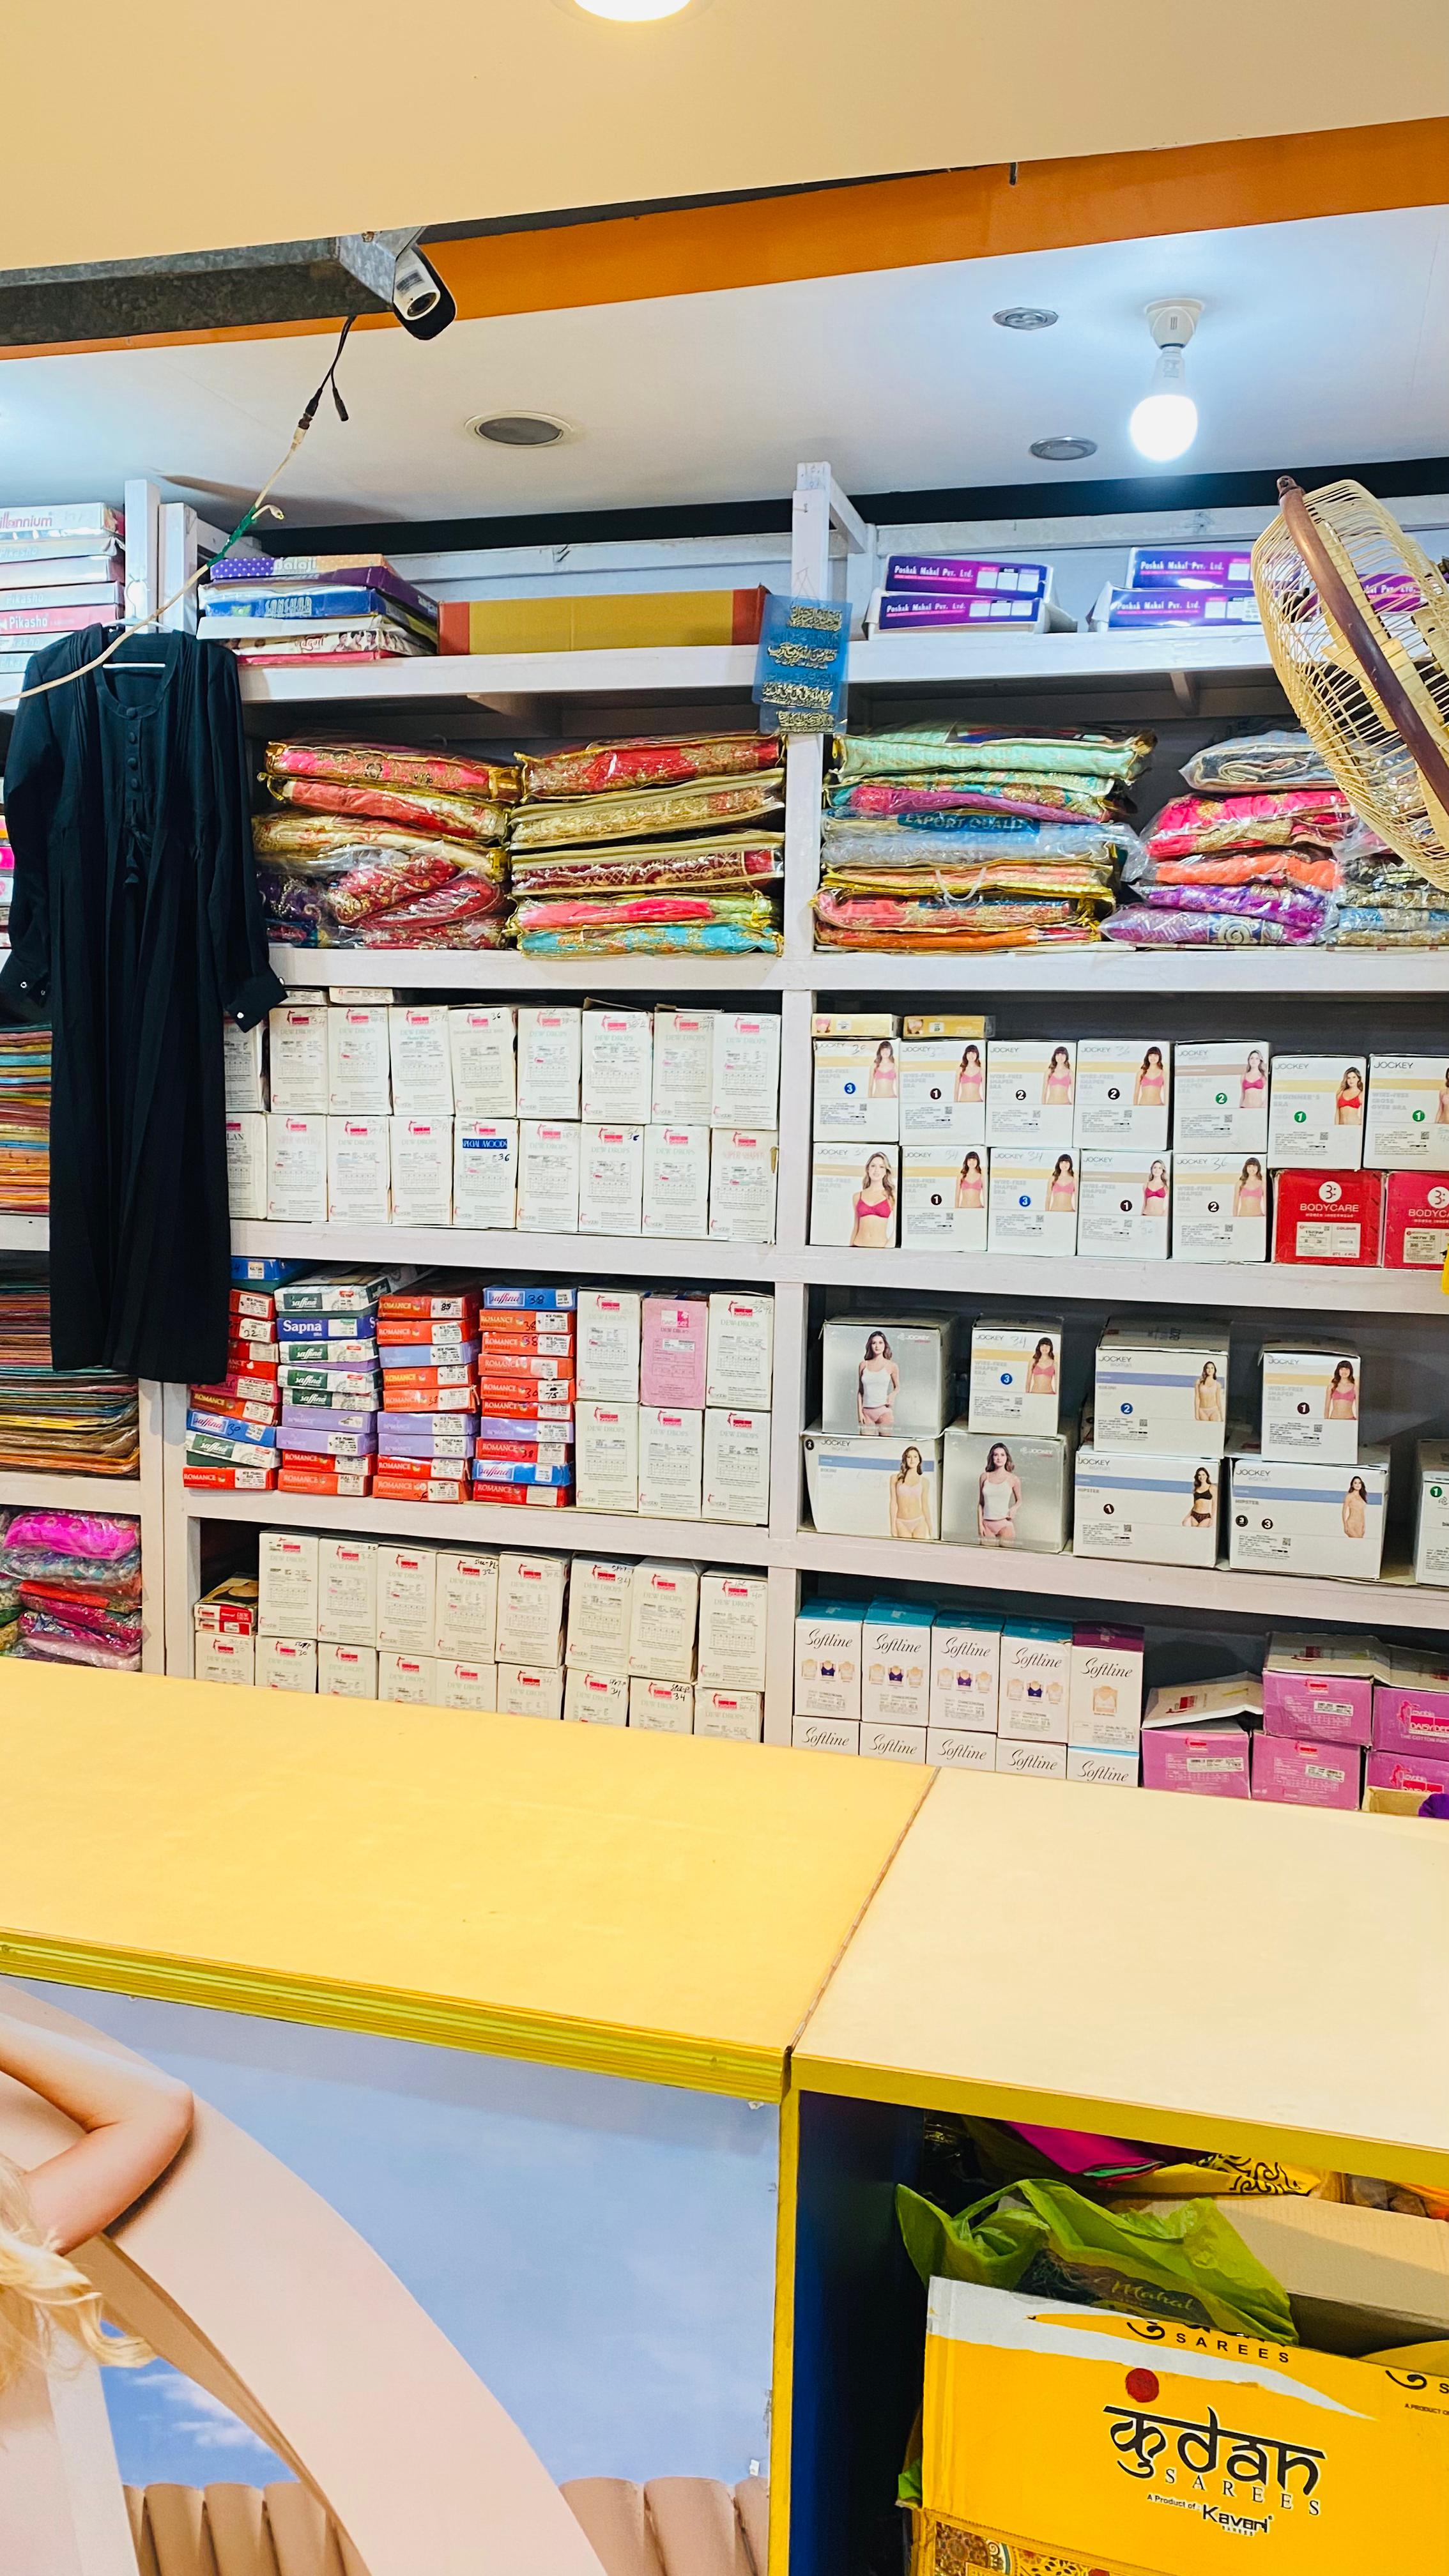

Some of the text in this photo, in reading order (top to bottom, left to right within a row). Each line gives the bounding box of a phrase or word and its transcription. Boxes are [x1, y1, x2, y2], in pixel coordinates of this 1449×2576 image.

[10, 614, 48, 629] Pikasho
[905, 812, 965, 829] EXPORT
[1374, 1061, 1413, 1070] JOCKEY
[1300, 1203, 1360, 1213] BODYCARE
[291, 1296, 318, 1308] saffina
[528, 1294, 544, 1305] 38
[282, 1319, 322, 1334] Sapna
[296, 1347, 323, 1359] saffina
[295, 1373, 322, 1386] saffina
[385, 1374, 416, 1383] ROMANCE
[194, 1393, 225, 1406] ROMANCE
[299, 1393, 326, 1404] saffina
[484, 1402, 518, 1410] ROMANCE
[199, 1441, 227, 1453] saffina
[482, 1443, 517, 1452] ROMANCE
[284, 1453, 318, 1462] ROMANCE
[183, 1473, 216, 1482] ROMANCE
[283, 1475, 319, 1484] ROMANCE
[378, 1482, 412, 1491] ROMANCE
[477, 1484, 512, 1493] ROMANCE
[714, 1598, 755, 1607] DEW DROPS
[804, 1628, 853, 1649] Softline
[872, 1633, 921, 1654] Softline
[940, 1636, 991, 1658] Softline
[1011, 1646, 1062, 1669] Softline
[1080, 1657, 1133, 1679] Softline
[673, 1693, 686, 1702] 34
[1410, 1722, 1433, 1732] DAISY
[801, 1726, 850, 1747] Softline
[868, 1733, 917, 1755] Softline
[937, 1738, 987, 1760] Softline
[1007, 1749, 1059, 1771] Softline
[1077, 1759, 1130, 1782] Softline
[1176, 2333, 1289, 2363] SAREES
[1165, 2468, 1320, 2516] SAREES
[1155, 2495, 1186, 2508] Product
[1222, 2525, 1254, 2536] SAREES
